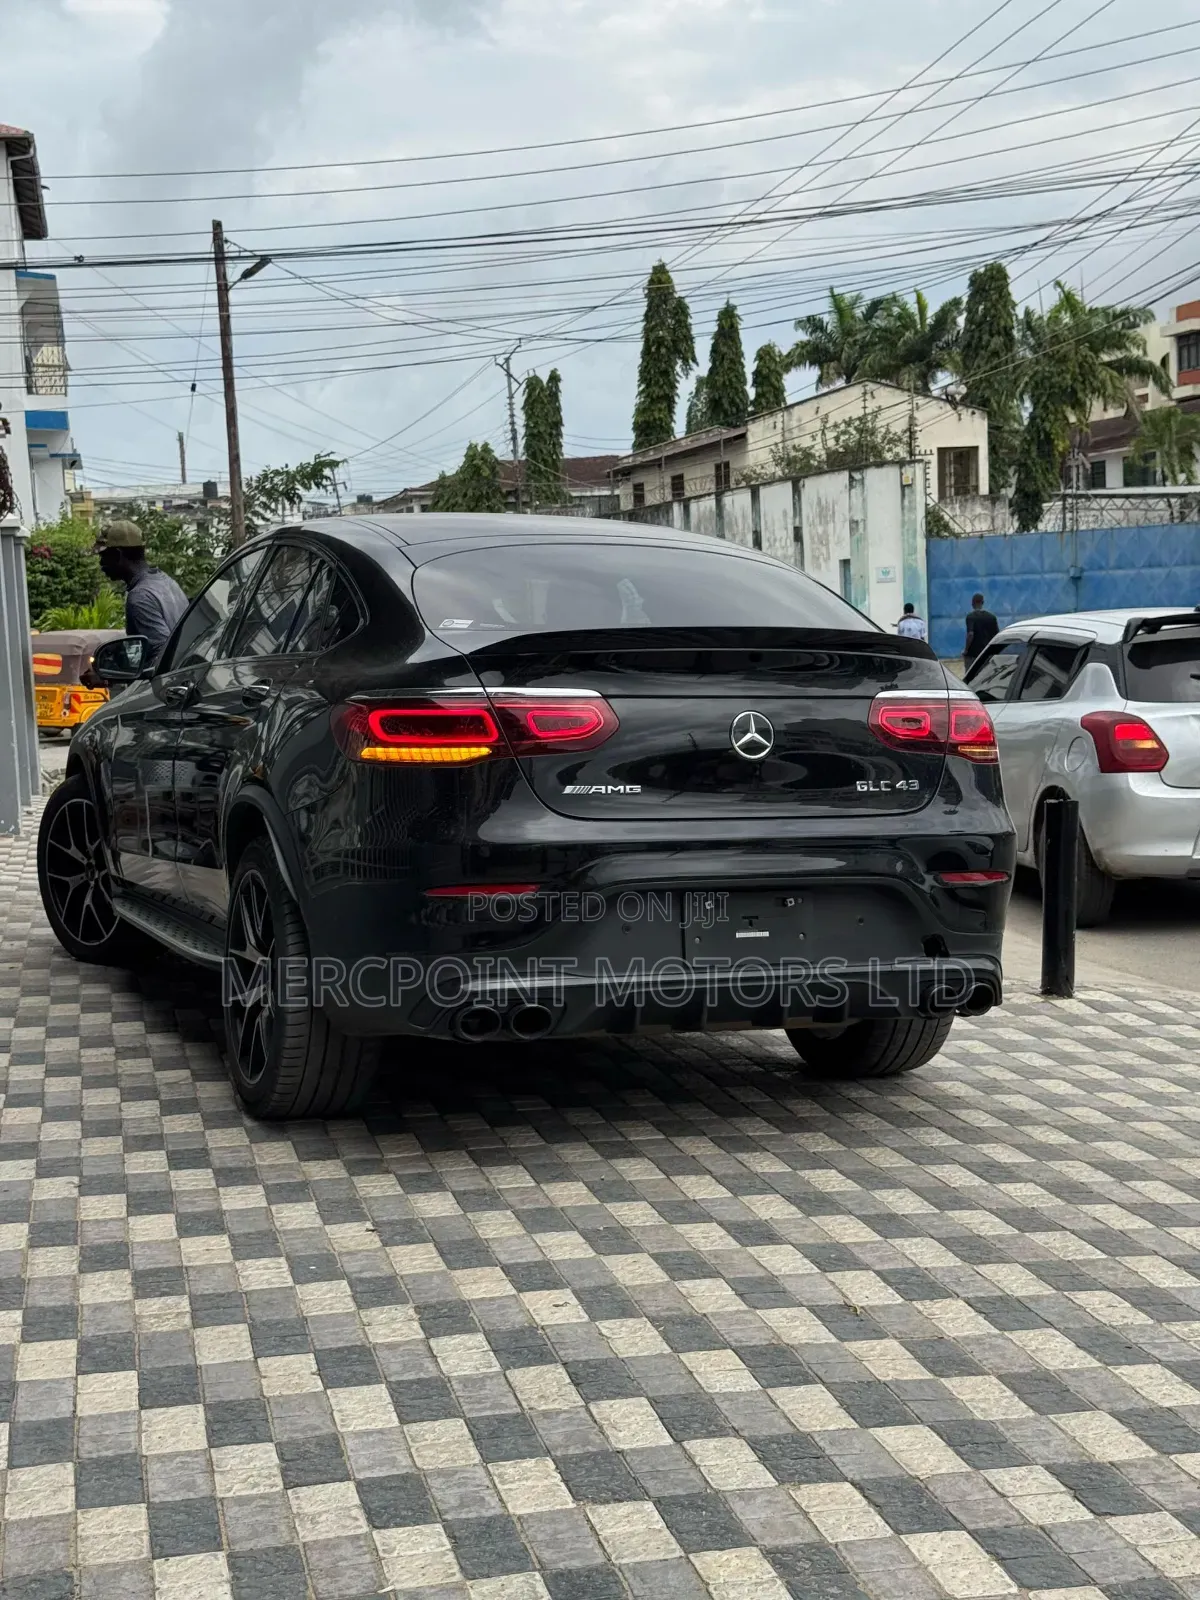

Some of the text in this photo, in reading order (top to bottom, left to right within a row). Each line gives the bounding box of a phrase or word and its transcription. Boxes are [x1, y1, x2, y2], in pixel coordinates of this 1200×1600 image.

[588, 785, 642, 794] AMG
[856, 779, 920, 792] GLC 43
